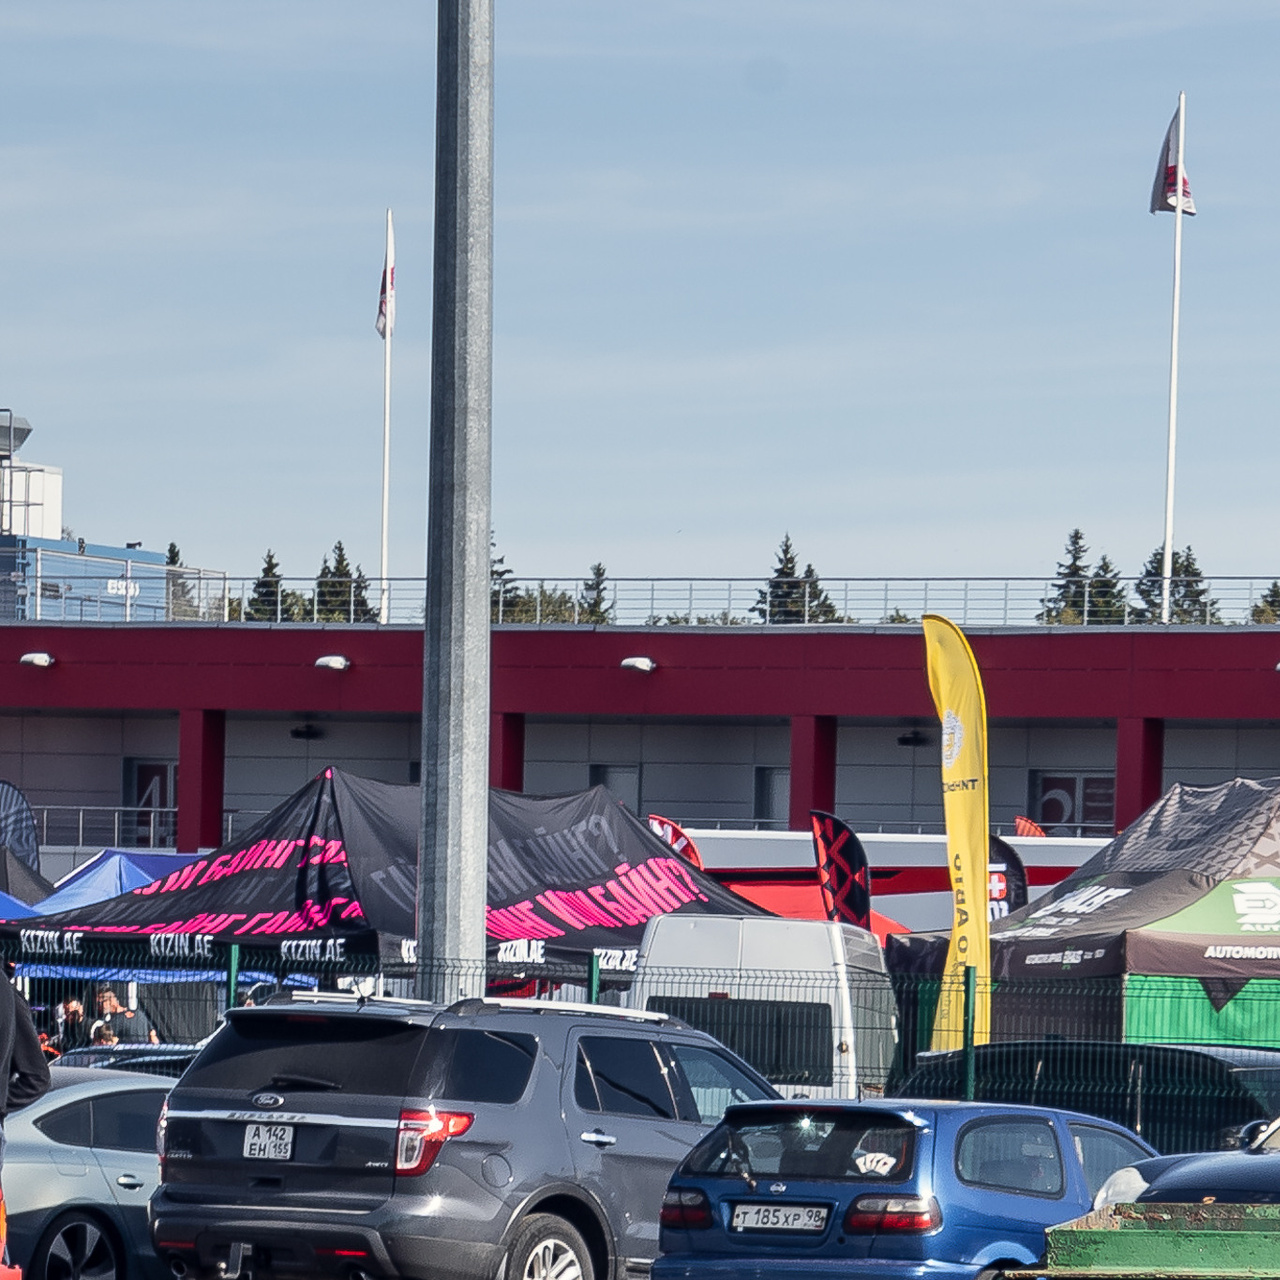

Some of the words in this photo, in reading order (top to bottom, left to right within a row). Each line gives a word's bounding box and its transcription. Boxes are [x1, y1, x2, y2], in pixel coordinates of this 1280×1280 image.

[20, 928, 84, 956] KIZIN.AE
[149, 932, 215, 959] KIZIN.AE
[280, 937, 346, 963] KIZIN.AE
[253, 1126, 260, 1138] A
[266, 1126, 287, 1141] 142
[248, 1142, 267, 1156] EH
[272, 1143, 289, 1155] 155
[754, 1207, 781, 1226] 185
[805, 1209, 821, 1222] 98
